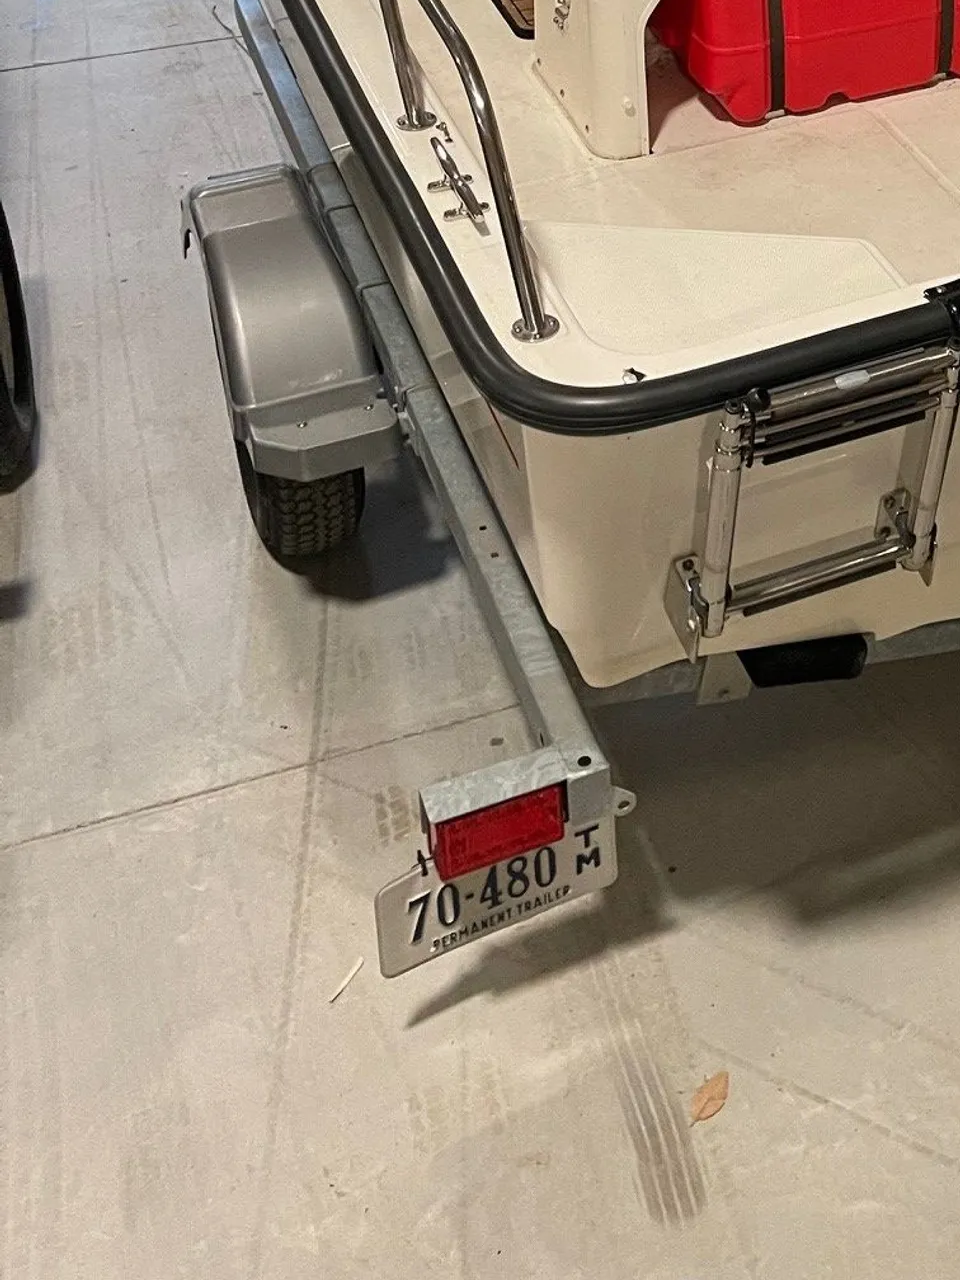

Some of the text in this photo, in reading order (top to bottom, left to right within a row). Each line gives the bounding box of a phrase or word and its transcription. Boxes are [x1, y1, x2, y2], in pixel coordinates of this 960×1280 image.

[407, 846, 557, 944] 70-480
[431, 884, 572, 954] PERMANENT TRAILER
